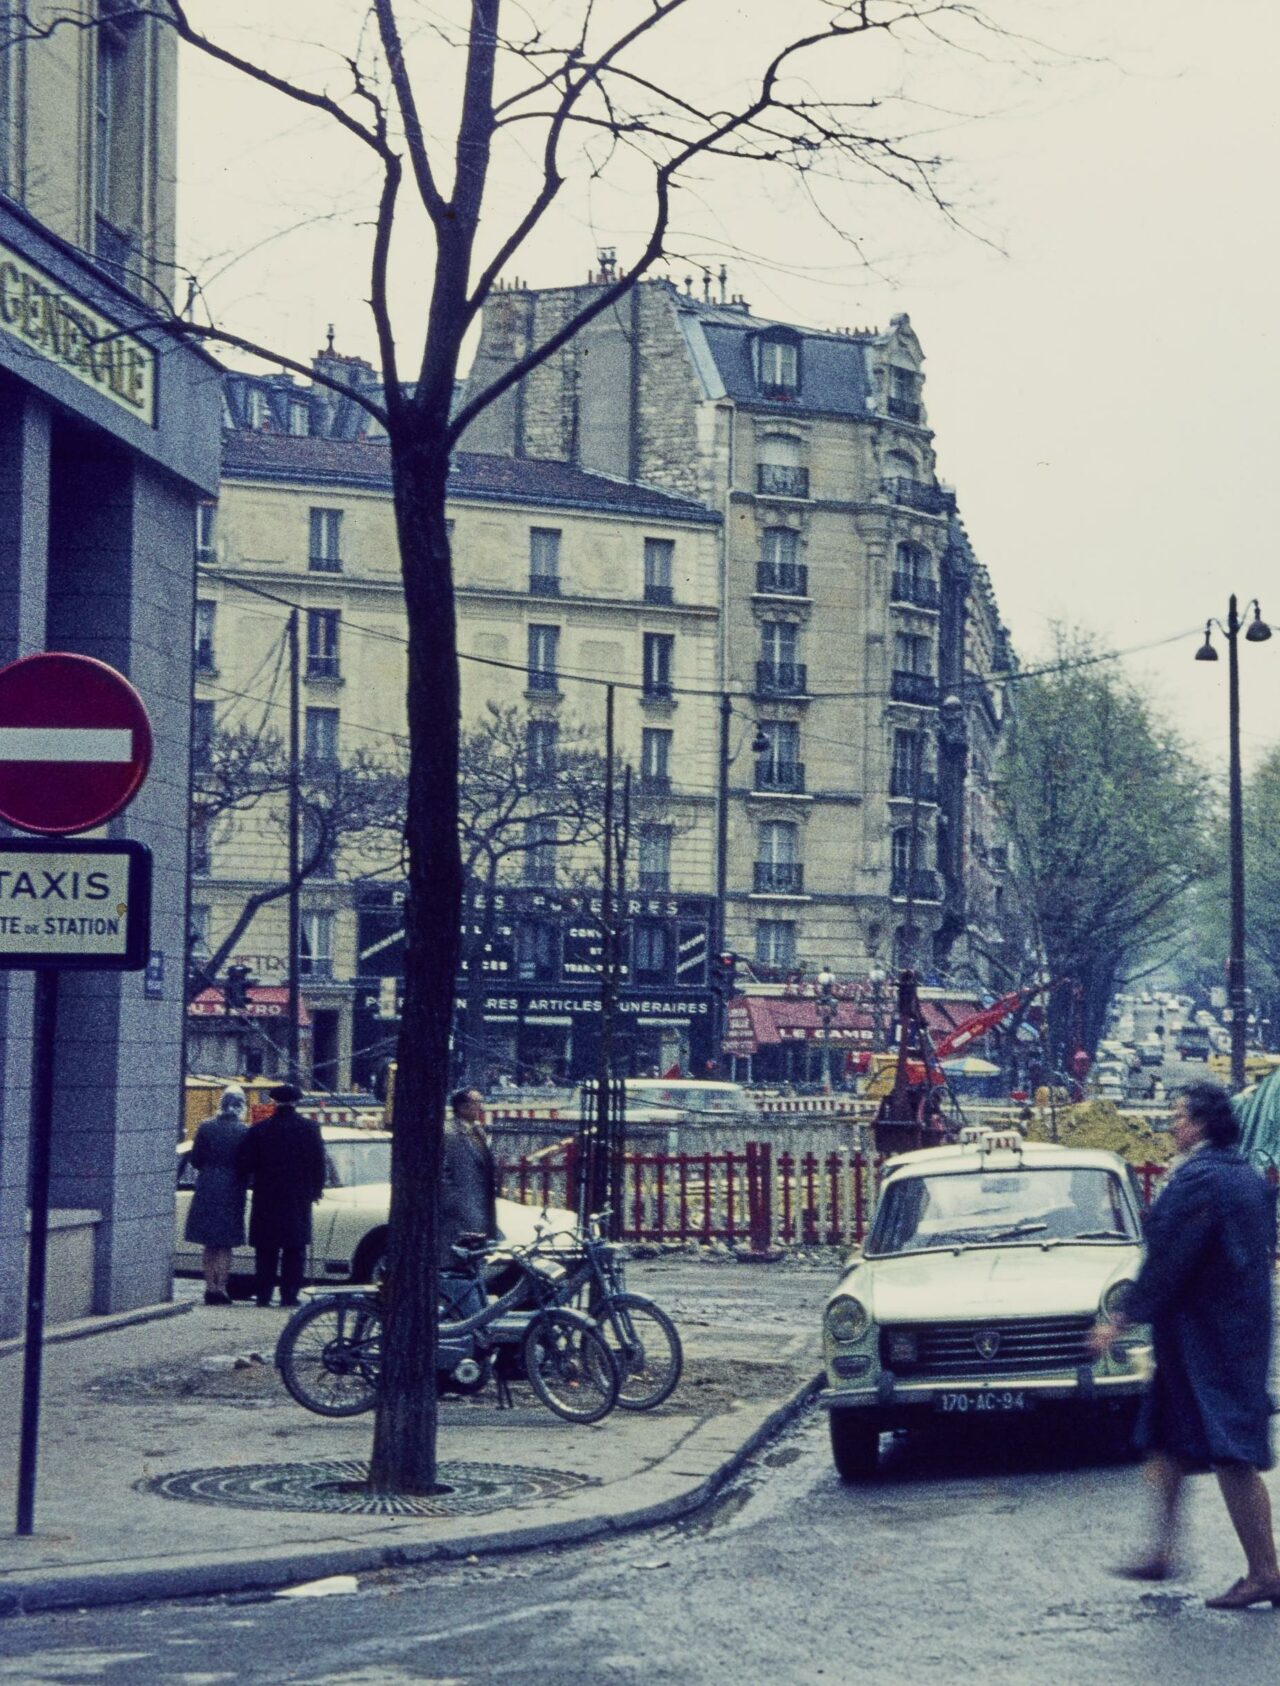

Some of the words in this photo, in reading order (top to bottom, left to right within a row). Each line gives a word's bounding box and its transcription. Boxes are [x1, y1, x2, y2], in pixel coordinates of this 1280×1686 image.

[44, 917, 119, 935] STATION
[529, 999, 602, 1012] ARTICLES
[986, 1136, 1017, 1149] TAXI
[941, 1391, 1026, 1411] 170-AC-94
